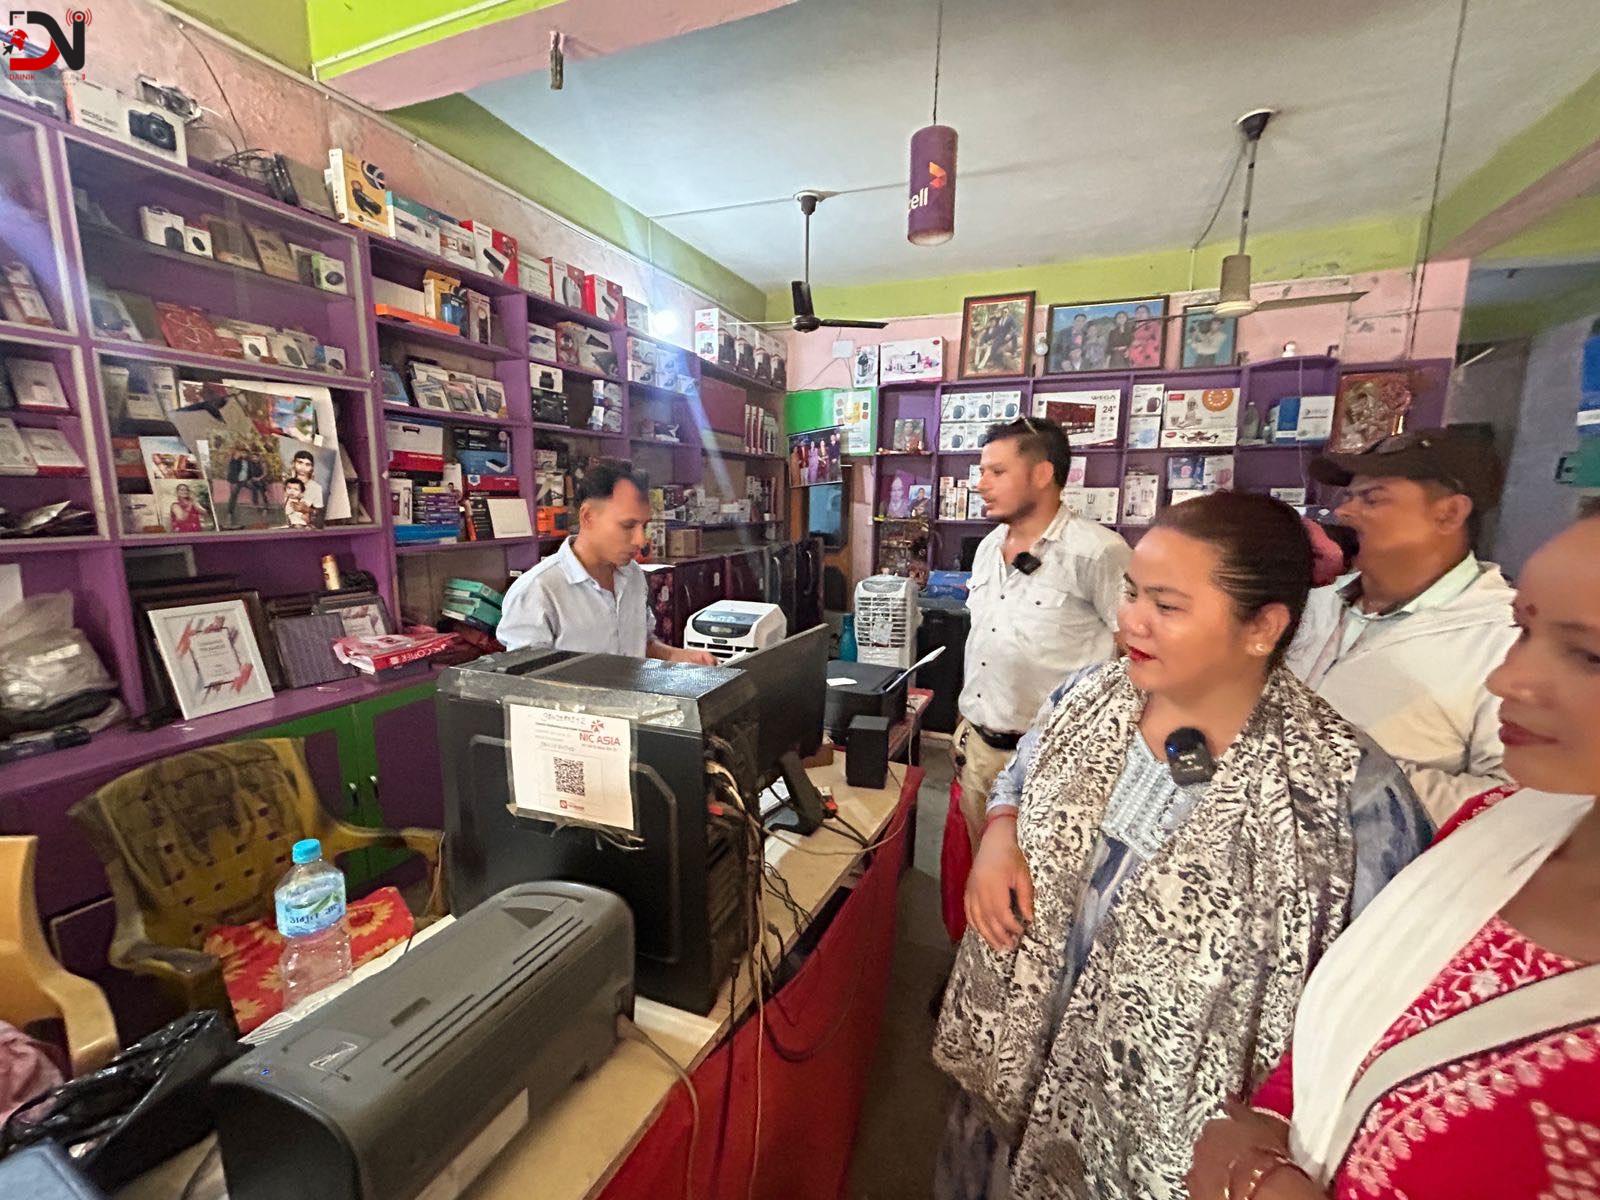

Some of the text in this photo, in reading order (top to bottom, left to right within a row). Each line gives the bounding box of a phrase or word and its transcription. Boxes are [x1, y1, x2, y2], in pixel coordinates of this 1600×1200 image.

[907, 187, 929, 214] ell
[579, 732, 595, 744] NIC
[597, 734, 621, 746] ASIA
